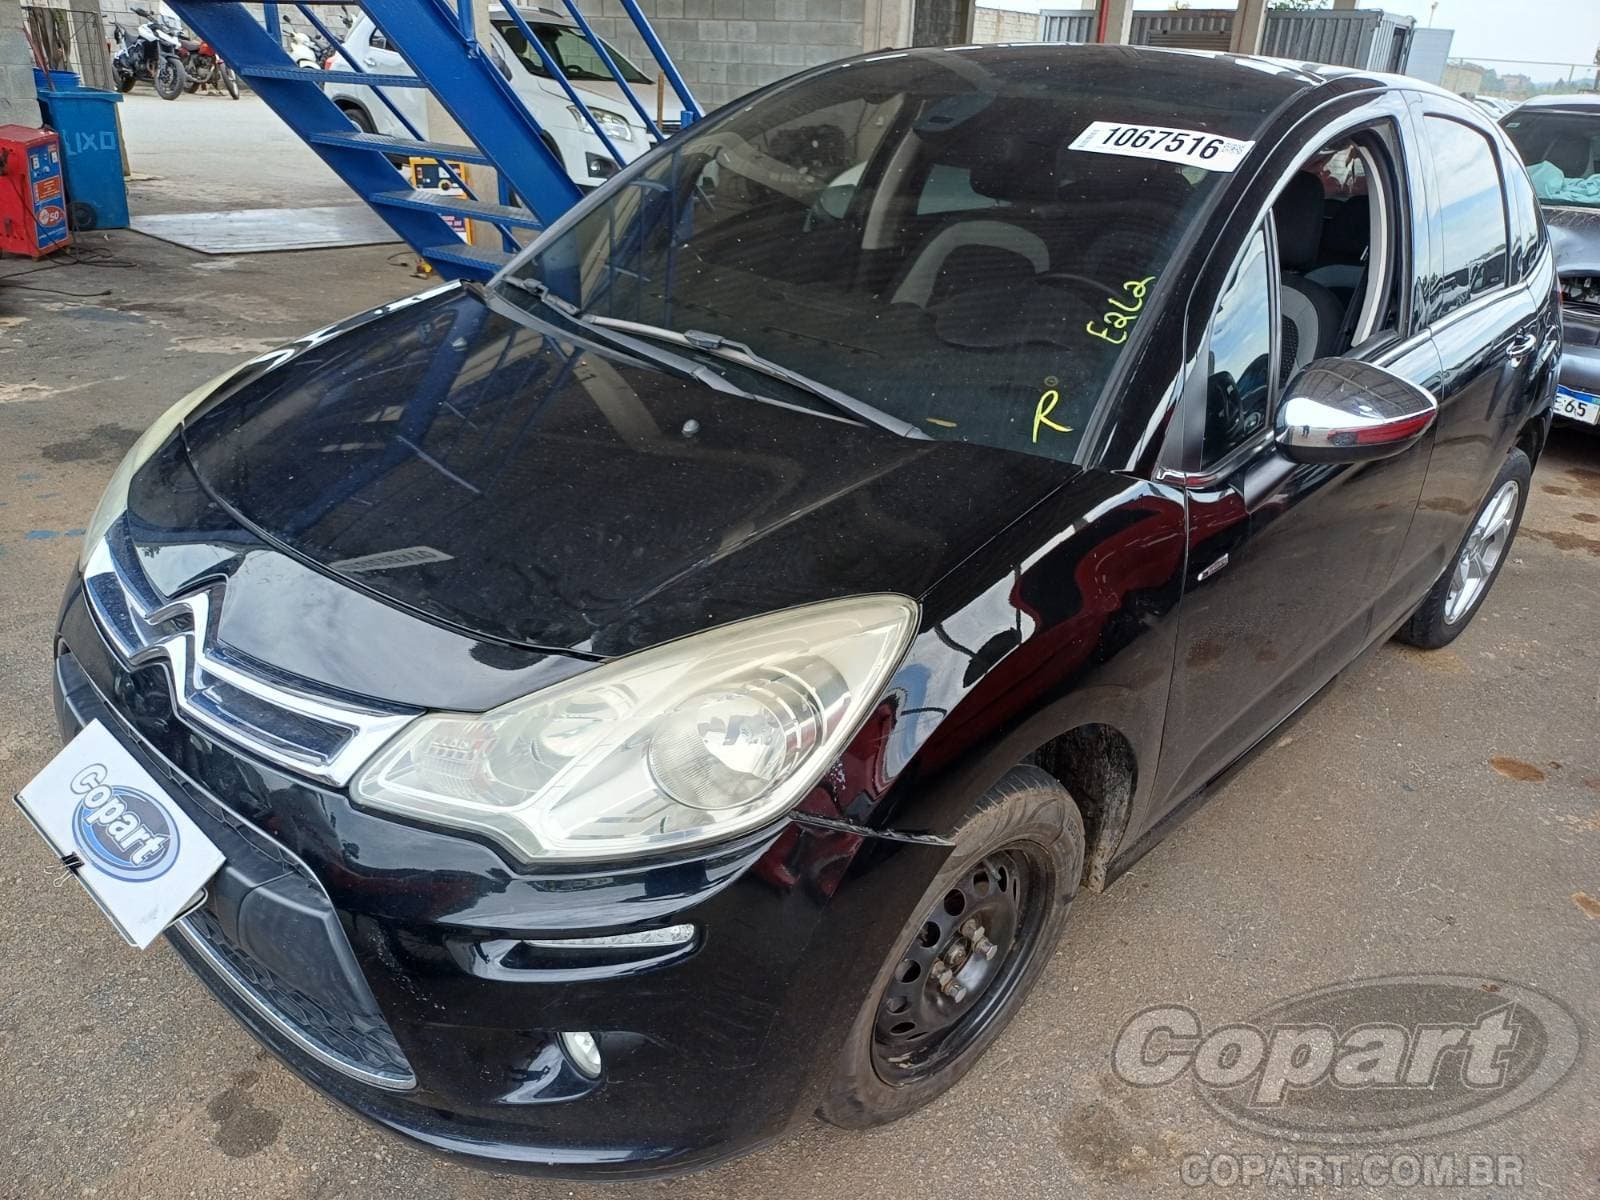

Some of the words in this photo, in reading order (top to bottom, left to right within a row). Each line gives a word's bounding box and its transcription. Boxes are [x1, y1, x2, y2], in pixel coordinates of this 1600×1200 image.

[62, 129, 116, 156] LIXO
[1102, 127, 1225, 160] 1067516
[1032, 390, 1075, 444] R
[70, 763, 171, 867] Copart
